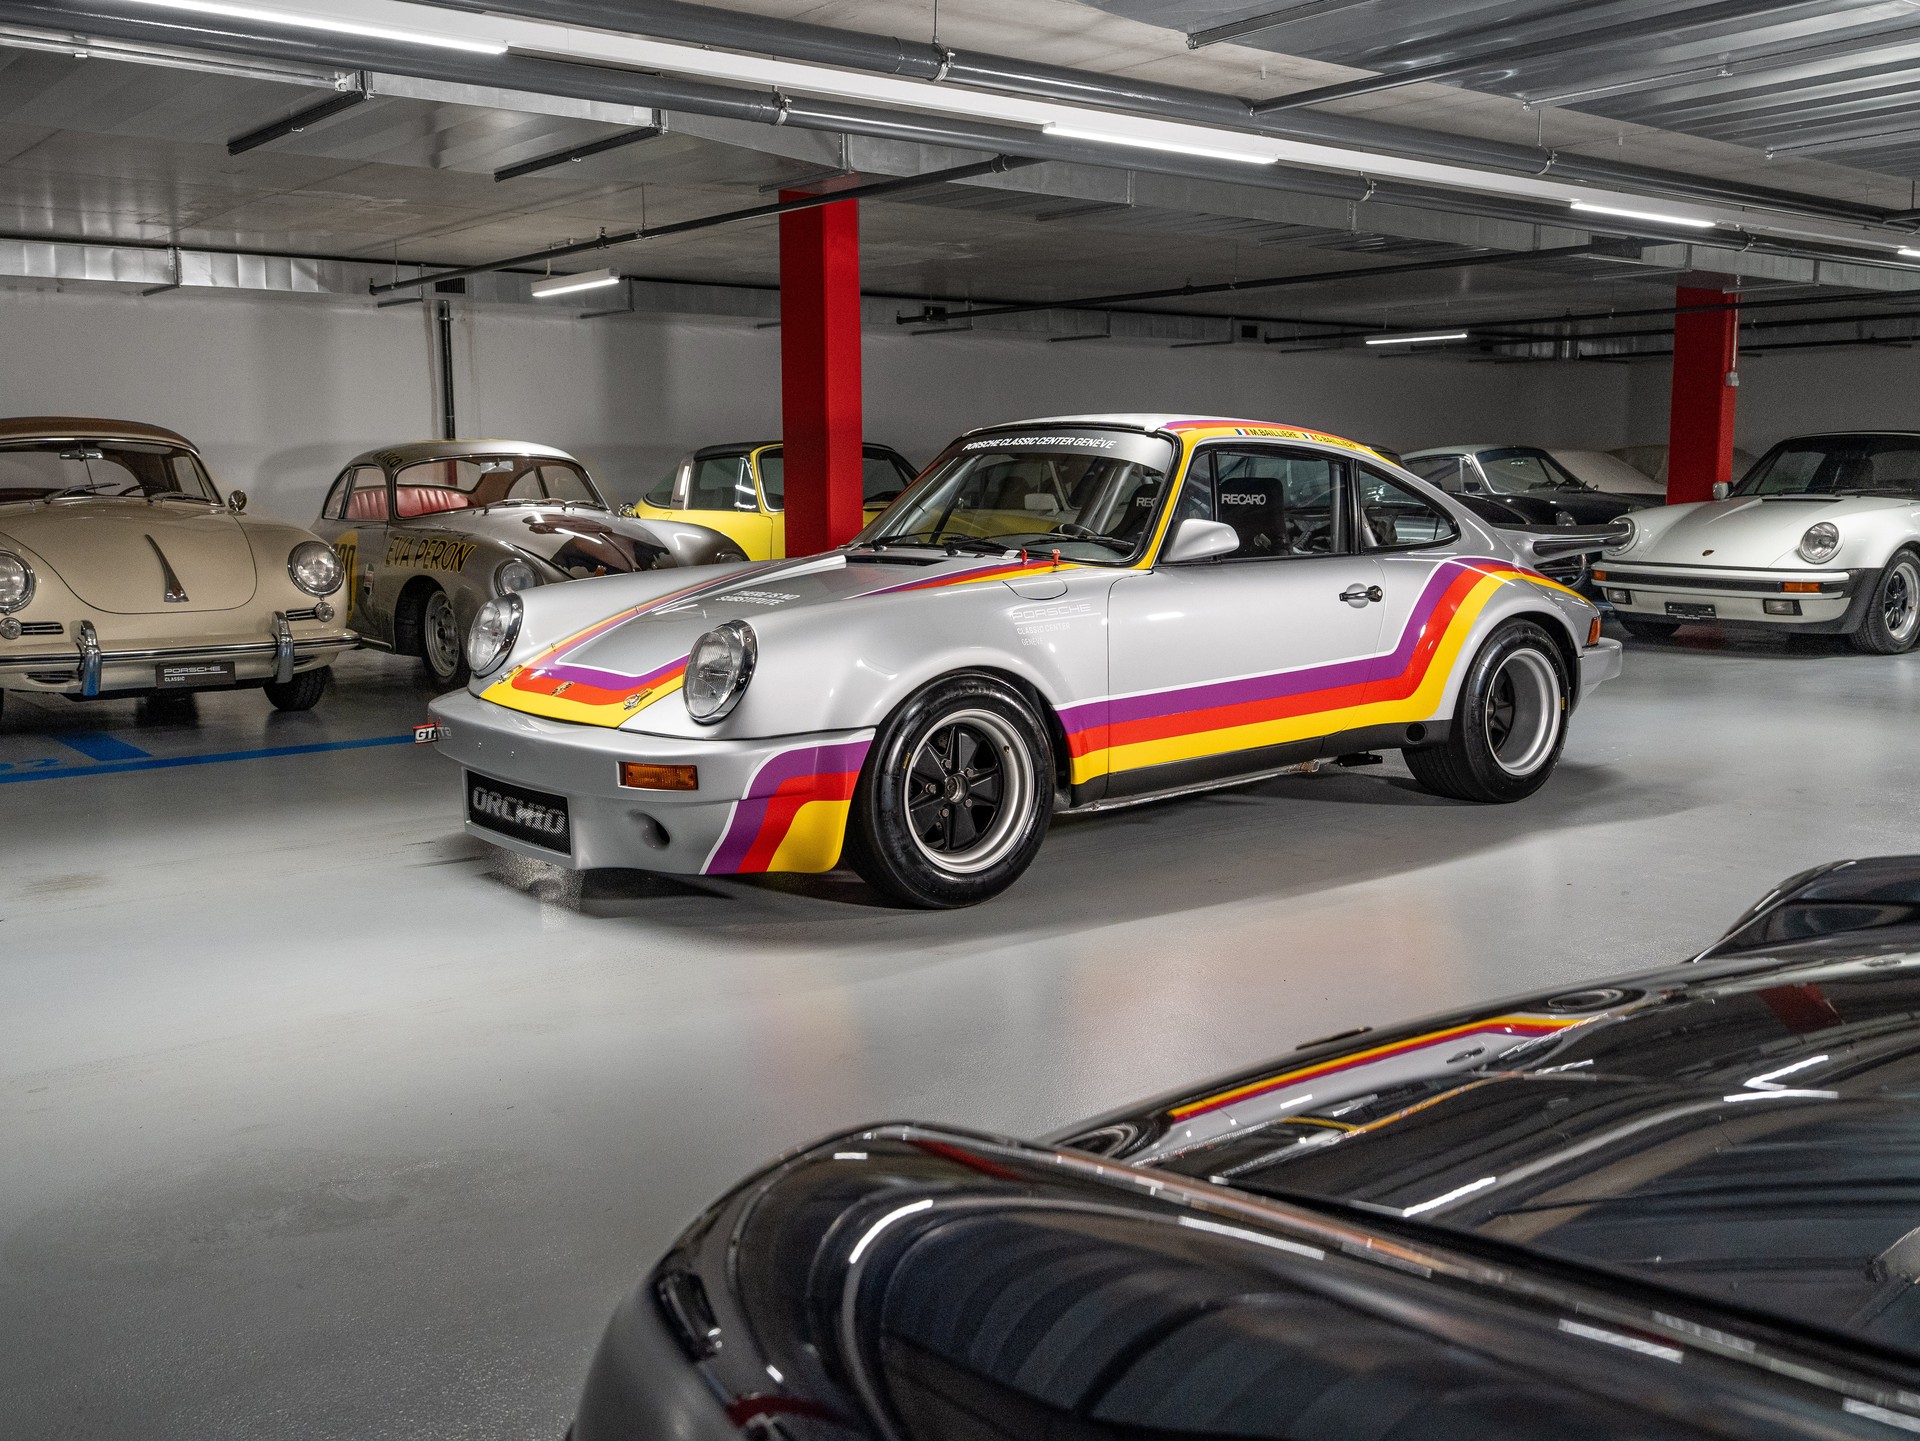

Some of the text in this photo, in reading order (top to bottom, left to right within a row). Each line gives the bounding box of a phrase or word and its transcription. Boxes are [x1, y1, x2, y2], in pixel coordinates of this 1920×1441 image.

[962, 436, 1117, 451] PORSCHE CLASSIC CENTER GENÈVE
[1221, 493, 1267, 506] RECARO
[385, 536, 414, 566] EVA
[1011, 603, 1091, 619] PORSCHE
[1016, 622, 1072, 635] CLASSIC CENTER
